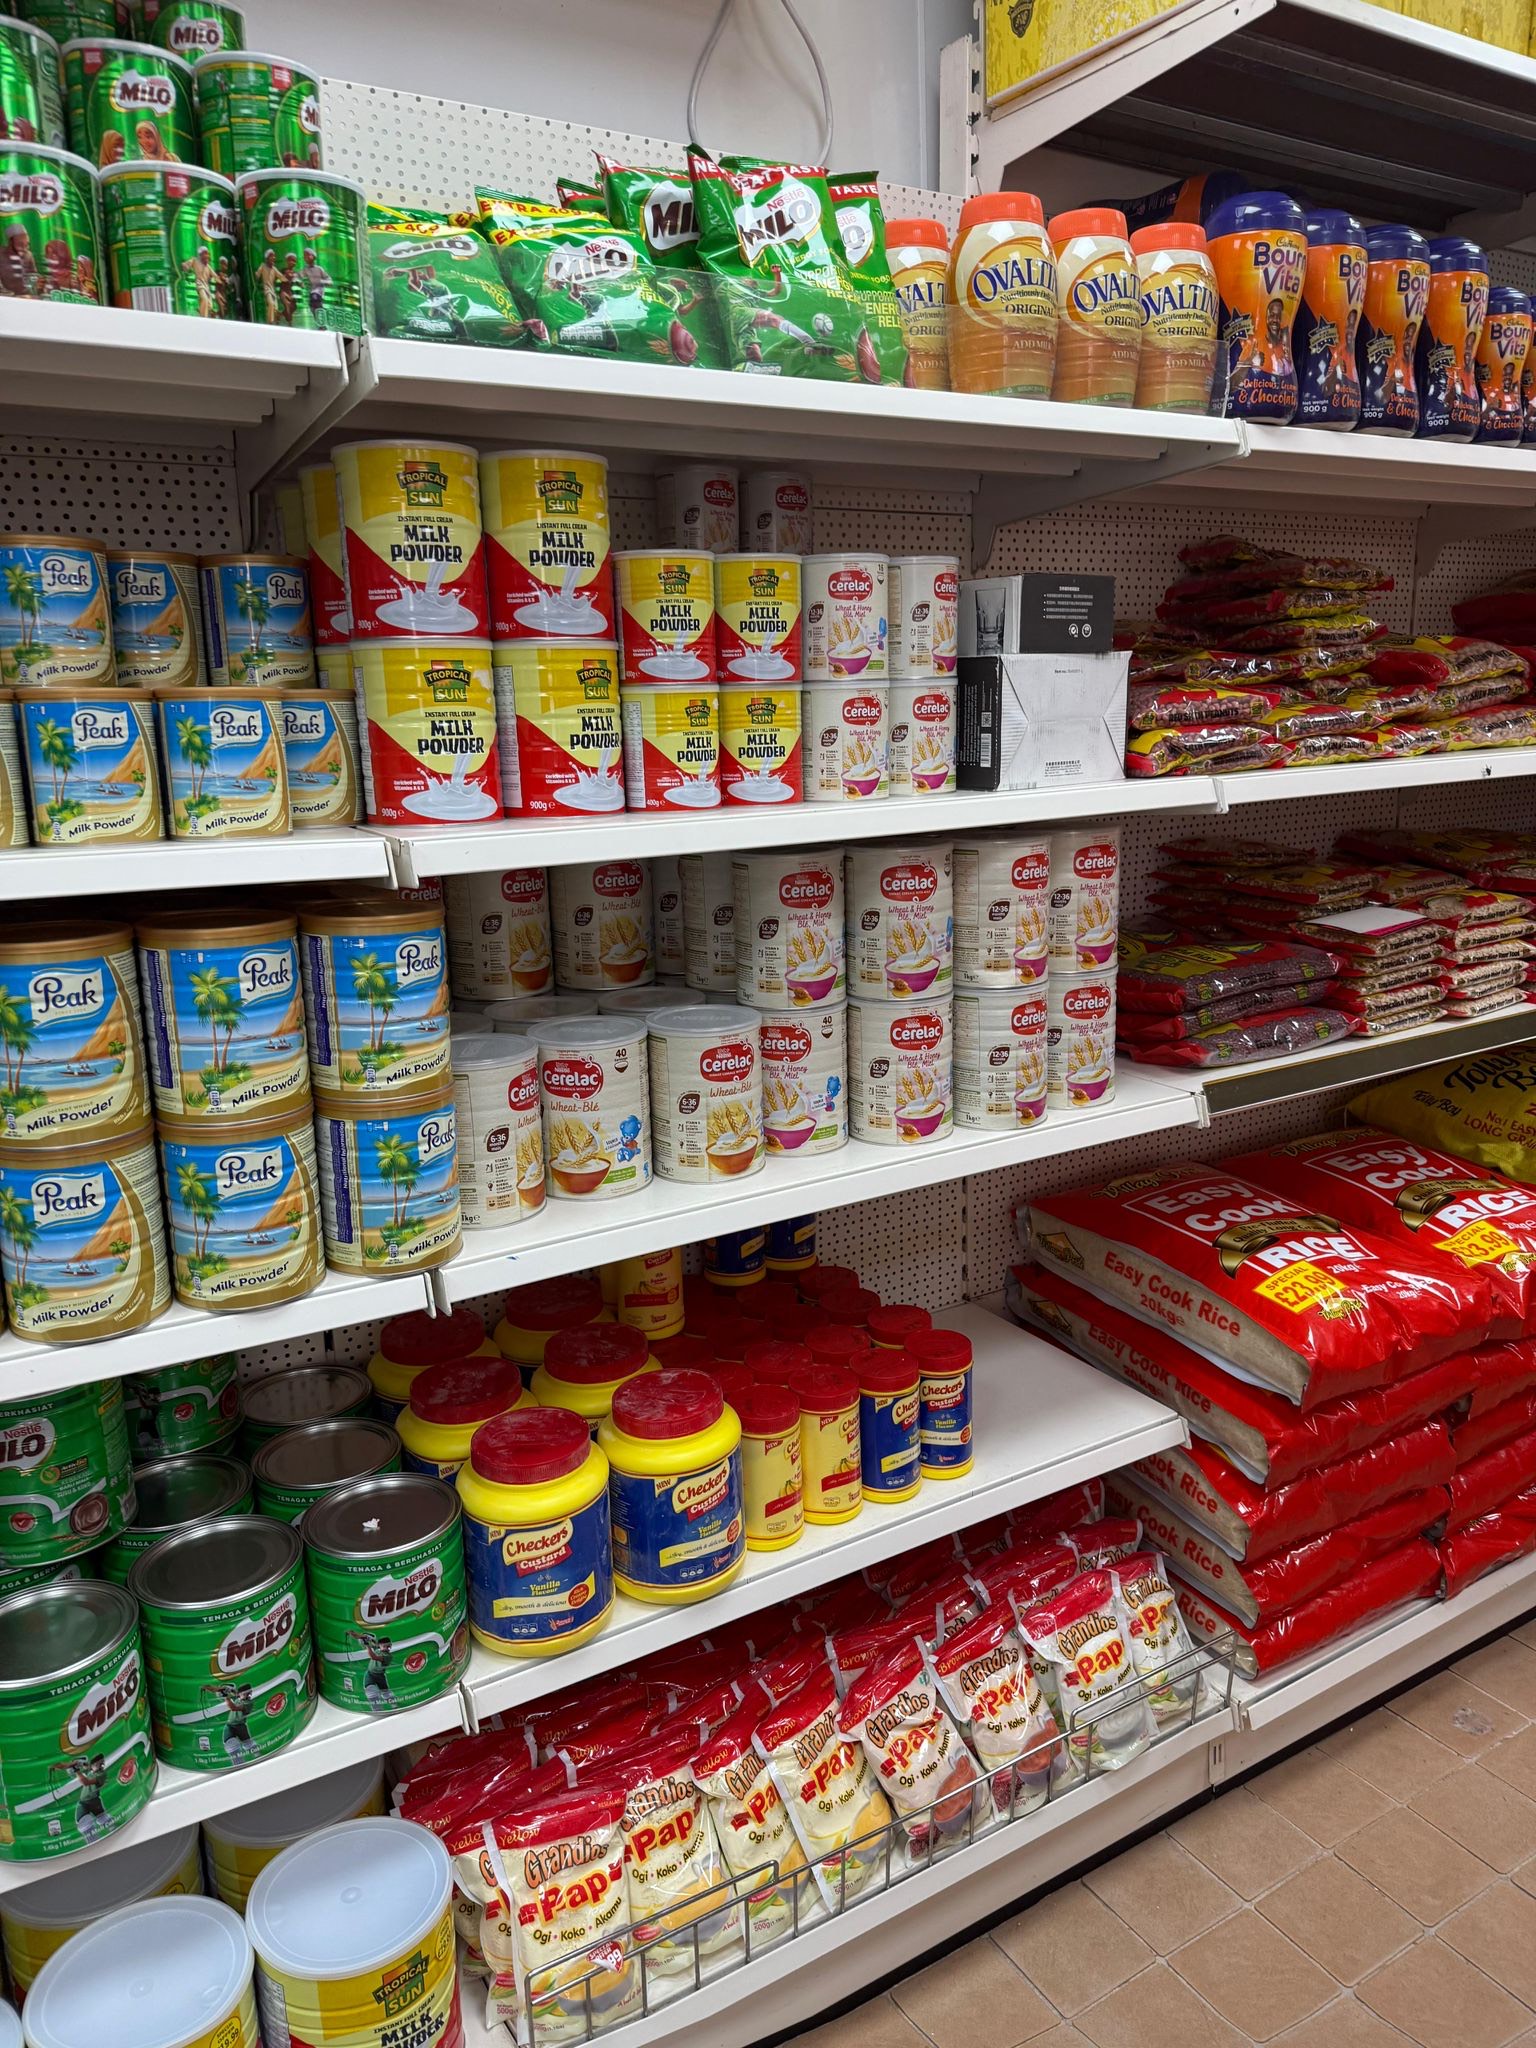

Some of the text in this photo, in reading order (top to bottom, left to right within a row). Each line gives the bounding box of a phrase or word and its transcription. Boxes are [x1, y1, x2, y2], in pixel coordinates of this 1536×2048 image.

[173, 24, 220, 46] MILO
[119, 80, 171, 105] MILO
[272, 207, 325, 231] MILO
[738, 200, 813, 246] MILO
[972, 256, 1057, 302] OVALTIN
[1262, 266, 1301, 296] Vita
[399, 471, 447, 486] TROPICAL
[539, 479, 583, 495] TROPICAL
[409, 492, 440, 505] SUN
[404, 525, 449, 543] MILK
[542, 531, 585, 548] MILK
[391, 544, 463, 564] POWDER
[528, 548, 596, 569] POWDER
[44, 558, 89, 587] Peak
[119, 568, 162, 597] Peak
[270, 571, 303, 601] Peak
[829, 580, 870, 592] Cerelac
[659, 605, 692, 619] MILK
[749, 606, 780, 620] MILK
[650, 618, 700, 633] POWDER
[739, 620, 787, 634] POWDER
[61, 659, 100, 675] Powder
[426, 671, 469, 686] TROPICAL
[435, 687, 464, 700] SUN
[844, 705, 880, 719] Cerelac
[913, 702, 949, 714] Cerelac
[75, 711, 124, 740] Peak
[212, 711, 259, 738] Peak
[430, 719, 473, 737] MILK
[581, 715, 614, 732] MILK
[418, 736, 485, 755] POWDER
[686, 736, 712, 749] MILK
[738, 746, 786, 759] POWDER
[747, 734, 778, 747] MILK
[677, 749, 717, 762] POWDER
[530, 799, 547, 811] 900g
[68, 813, 136, 838] Milk Powder
[205, 809, 269, 832] Milk Powder
[1075, 856, 1116, 870] Cerelac
[594, 874, 641, 888] Cerelac
[782, 883, 831, 897] Cerelac
[882, 877, 935, 891] Cerelac
[863, 915, 879, 923] 12-36
[243, 954, 291, 989] Peak
[399, 943, 440, 977] Peak
[37, 976, 99, 1012] Peak
[1065, 997, 1109, 1011] Cerelac
[822, 1015, 832, 1025] 40
[892, 1025, 942, 1041] Cerelac
[615, 1048, 627, 1058] 40
[703, 1055, 751, 1073] Cerelac
[386, 1049, 448, 1085] Milk Powder
[543, 1069, 600, 1086] Cerelac
[1444, 1055, 1520, 1093] Tolly
[232, 1070, 302, 1108] Milk Powder
[710, 1082, 752, 1098] Wheat-Blé
[26, 1096, 114, 1134] Milk Powder
[550, 1100, 600, 1114] Wheat-Blé
[421, 1120, 454, 1153] Peak
[491, 1133, 508, 1143] 6-36
[1464, 1115, 1502, 1137] LONG
[1325, 1146, 1427, 1172] Easy
[222, 1156, 278, 1191] Peak
[39, 1181, 98, 1216] Peak
[1144, 1179, 1254, 1214] Easy
[1184, 1199, 1301, 1232] Cook
[408, 1239, 433, 1258] Milk
[1256, 1236, 1361, 1269] RICE
[211, 1262, 289, 1296] Milk Powder
[1265, 1266, 1307, 1290] SPECIAL
[1274, 1271, 1336, 1308] £23.99
[1104, 1251, 1241, 1336] Easy Cook Rice
[31, 1294, 116, 1326] Milk Powder
[1139, 1294, 1178, 1325] 20kg
[922, 1380, 963, 1395] Checkers
[1174, 1381, 1212, 1413] Rice
[929, 1395, 961, 1407] Custard
[4, 1424, 42, 1440] Nestlé
[821, 1417, 834, 1425] NEW
[656, 1479, 671, 1489] NEW
[677, 1466, 728, 1502] Checkers
[1181, 1470, 1219, 1514] Rice
[690, 1487, 727, 1514] Custard
[506, 1527, 568, 1557] Checkers
[395, 1543, 443, 1568] BERKHASIAT
[520, 1549, 567, 1570] Custard
[1183, 1537, 1224, 1578] Rice
[404, 1564, 434, 1586] Nestlé
[529, 1580, 561, 1591] Vanilla
[202, 1610, 241, 1623] TENAGA
[253, 1575, 296, 1610] BERKHASIAT
[368, 1574, 436, 1618] MILO
[264, 1598, 290, 1624] Nestlé
[226, 1610, 292, 1666] MILO
[1057, 1612, 1117, 1660] Grandios
[941, 1648, 971, 1673] Brown
[959, 1647, 1019, 1696] Grandios
[1077, 1639, 1124, 1686] Pap
[49, 1675, 92, 1697] TENAGA
[77, 1668, 139, 1739] MILO
[866, 1692, 929, 1749] Grandios
[815, 1743, 856, 1793] Pap
[899, 1762, 938, 1787] Ogi Koko
[818, 1799, 834, 1815] Ogi
[499, 1826, 540, 1847] Yellow
[631, 1809, 693, 1864] Pap
[524, 1836, 609, 1889] Grandios
[632, 1863, 678, 1883] Ogi Koko
[541, 1870, 607, 1925] Pap
[533, 1896, 622, 1945] Ogi Koko Akamu
[376, 1962, 426, 1999] TROPICAL
[388, 1983, 422, 2014] SUN
[374, 1993, 435, 2034] INSTANT FULL CREAM
